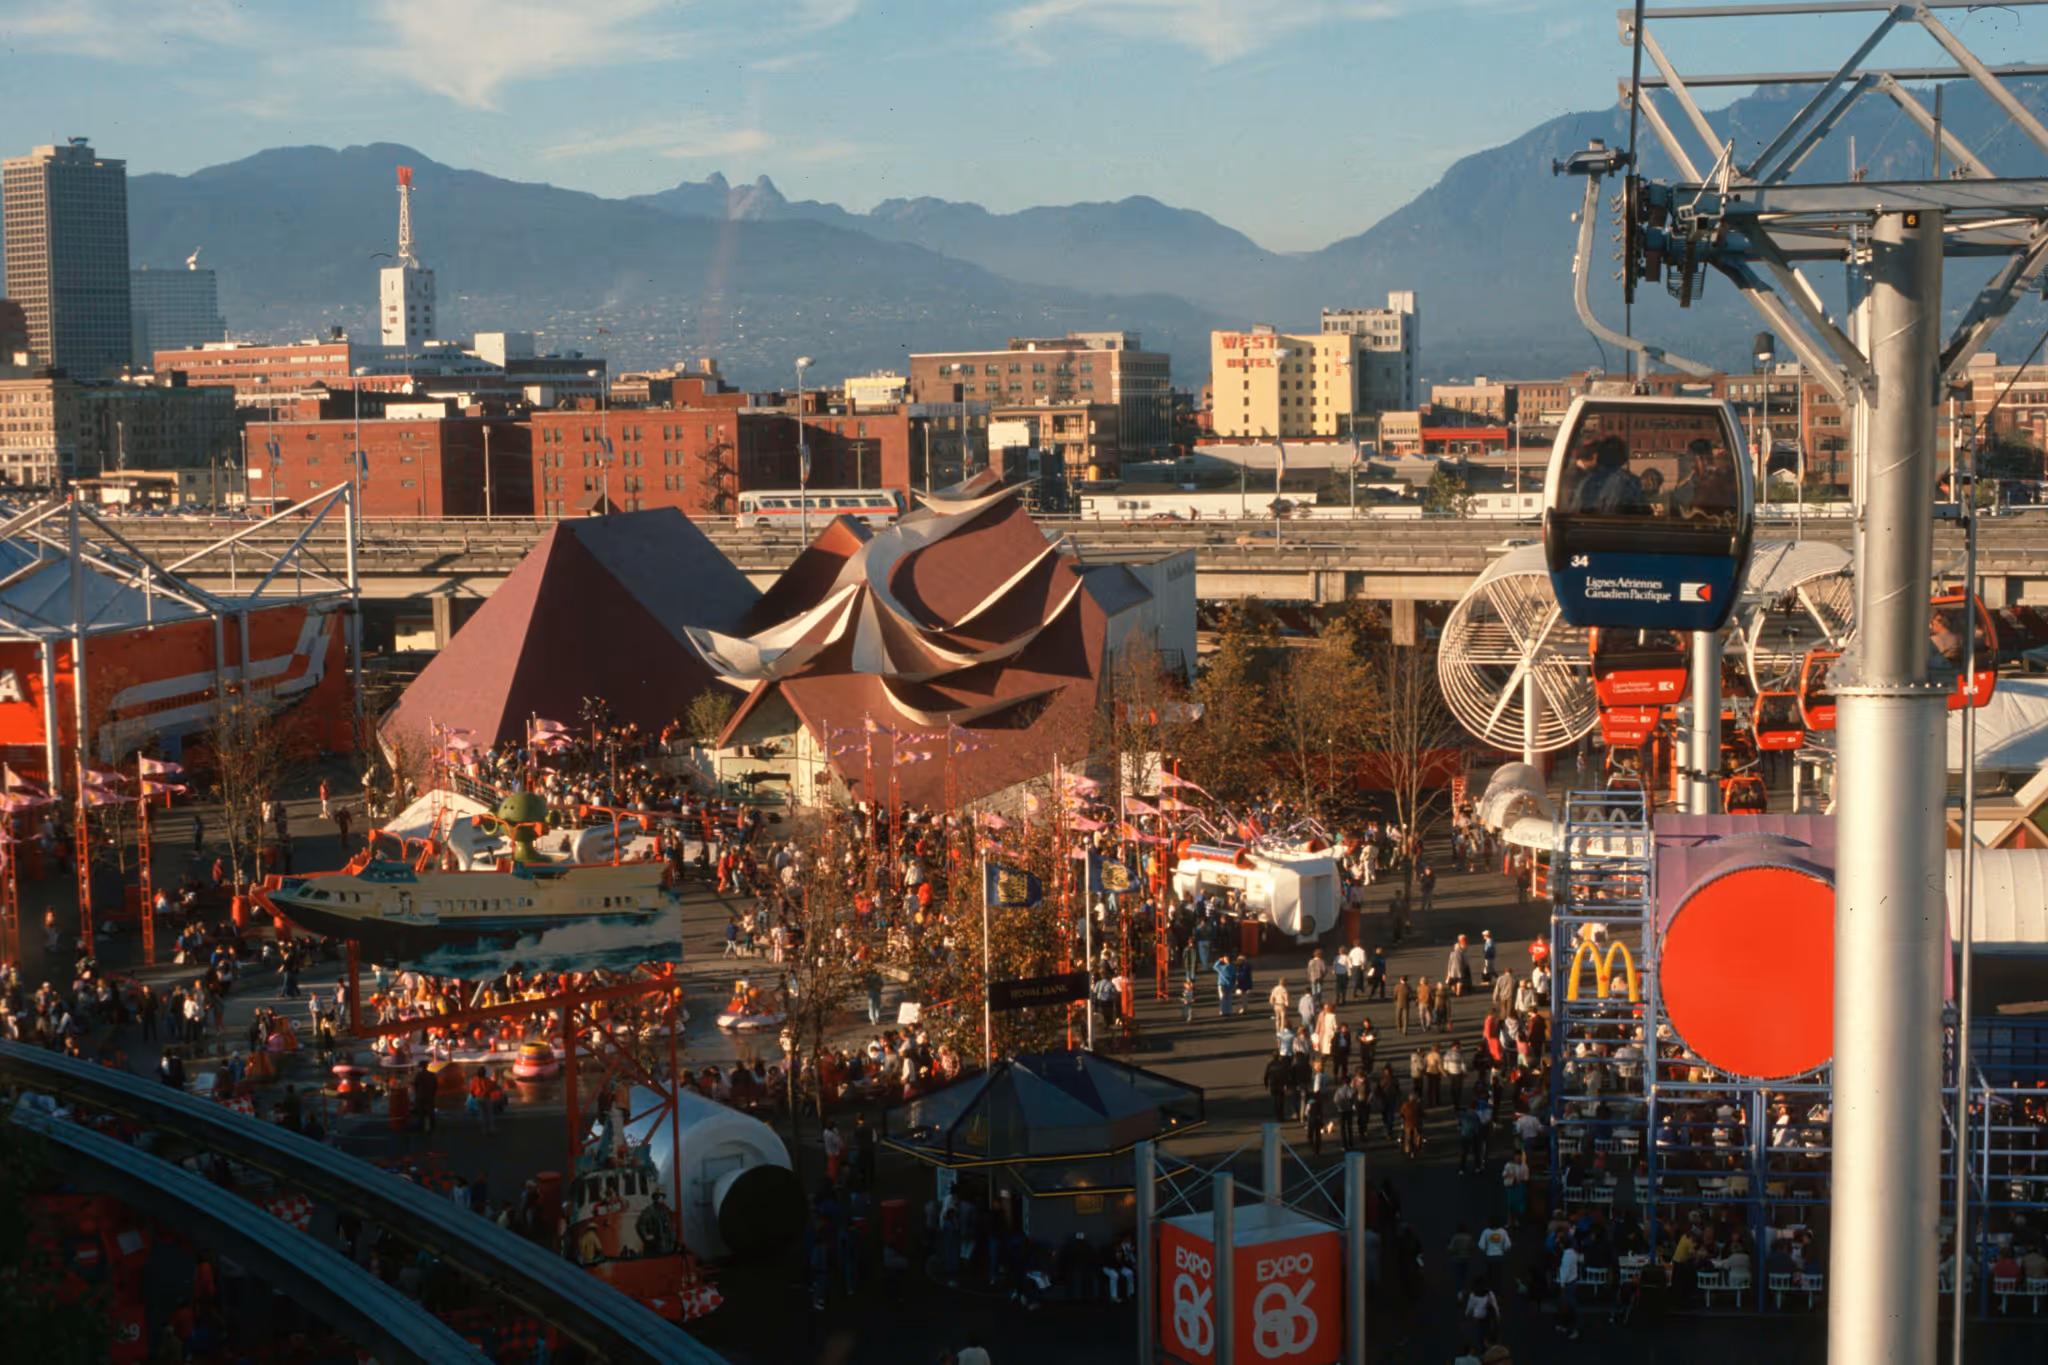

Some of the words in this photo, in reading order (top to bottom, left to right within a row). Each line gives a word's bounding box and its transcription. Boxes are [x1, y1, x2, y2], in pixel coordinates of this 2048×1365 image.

[1907, 214, 1916, 224] 6
[1221, 334, 1274, 349] WEST
[1226, 357, 1275, 368] HOTEL
[1570, 554, 1589, 567] 34
[1585, 575, 1616, 590] Lignes
[1584, 587, 1629, 598] Canadien
[1629, 588, 1672, 603] Pacifique
[1176, 1245, 1211, 1280] EXPO
[1256, 1252, 1314, 1282] EXPO
[1173, 1272, 1214, 1356] 86
[1253, 1278, 1318, 1359] 86
